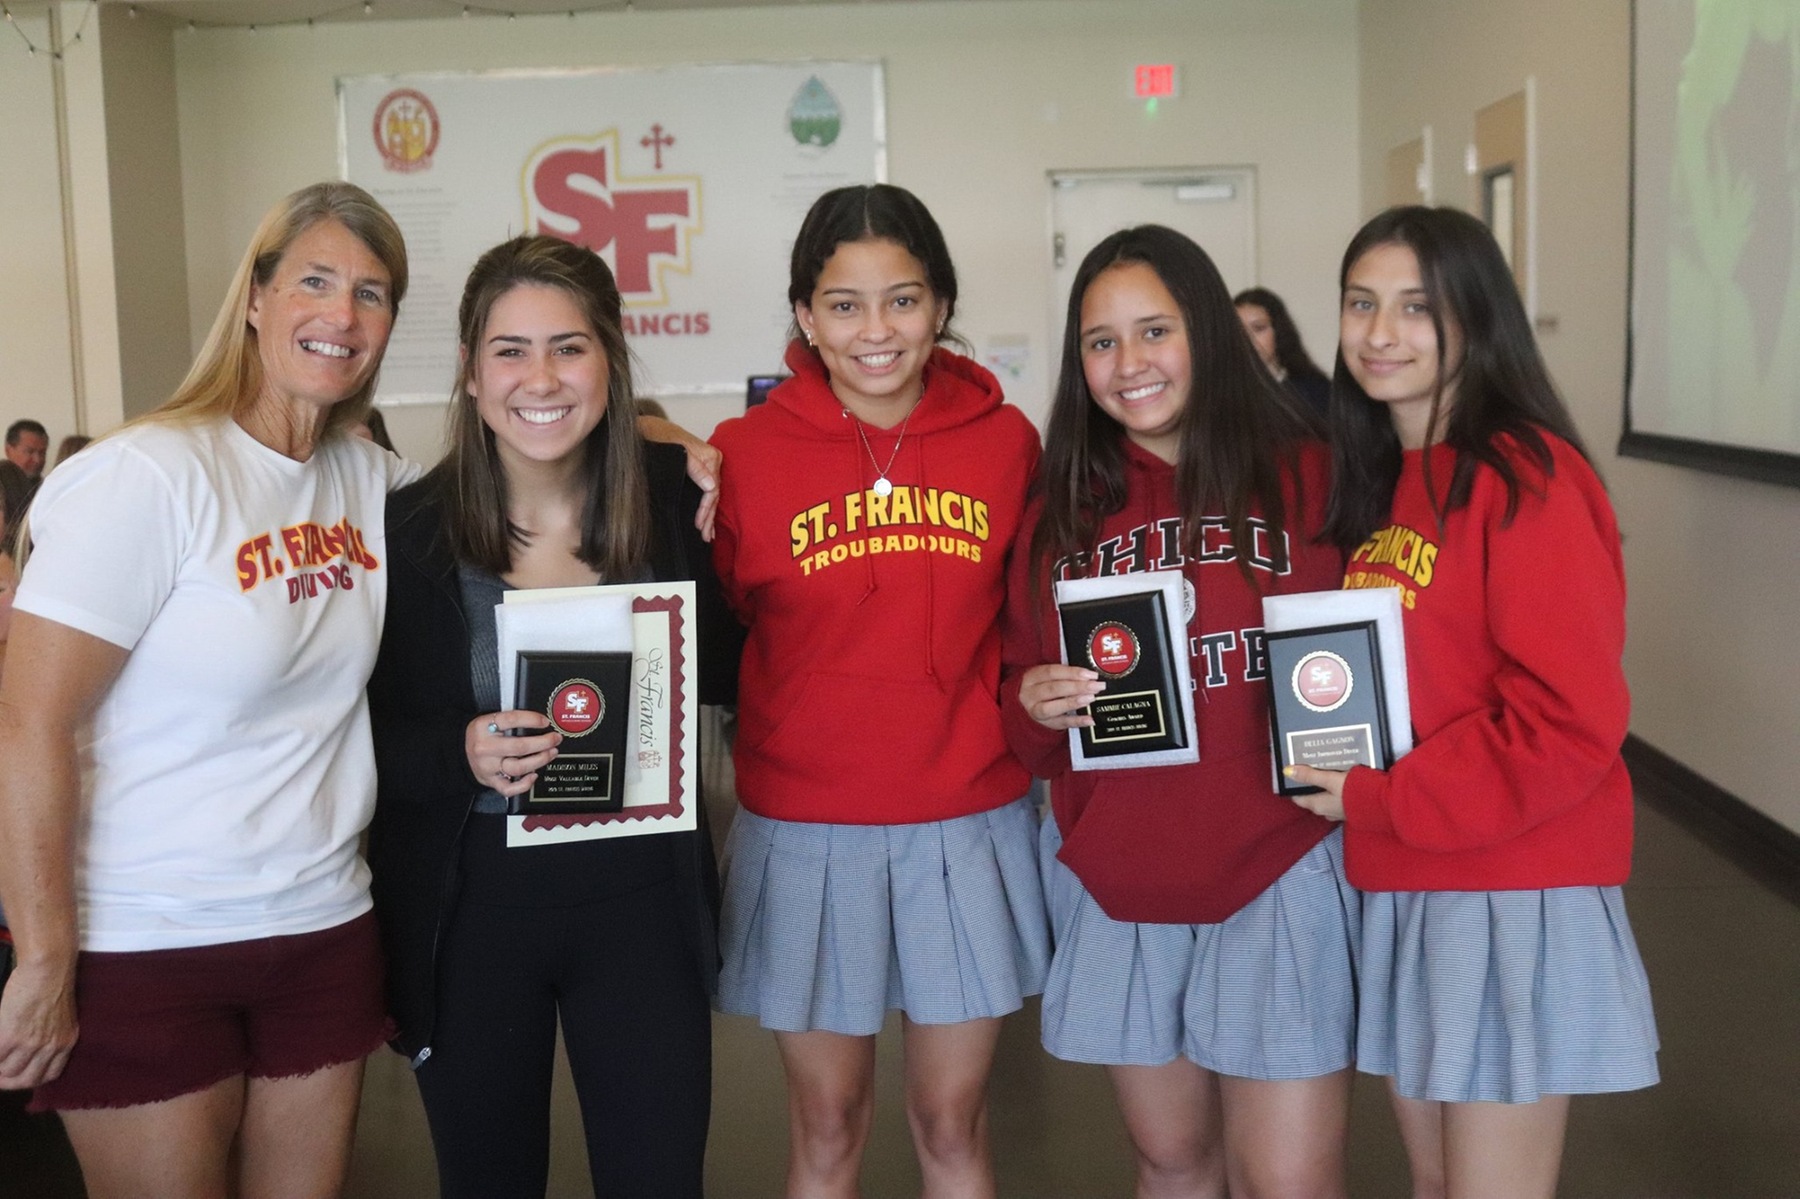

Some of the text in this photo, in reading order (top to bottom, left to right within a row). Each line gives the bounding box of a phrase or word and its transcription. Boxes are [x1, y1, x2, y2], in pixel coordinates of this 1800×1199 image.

[533, 146, 690, 293] SF
[620, 311, 710, 336] ANCIS
[789, 484, 990, 559] ST. FRANCIS
[235, 529, 285, 593] ST.
[799, 534, 982, 576] TROUBADOURS
[566, 691, 588, 713] SF
[637, 677, 663, 747] Francis
